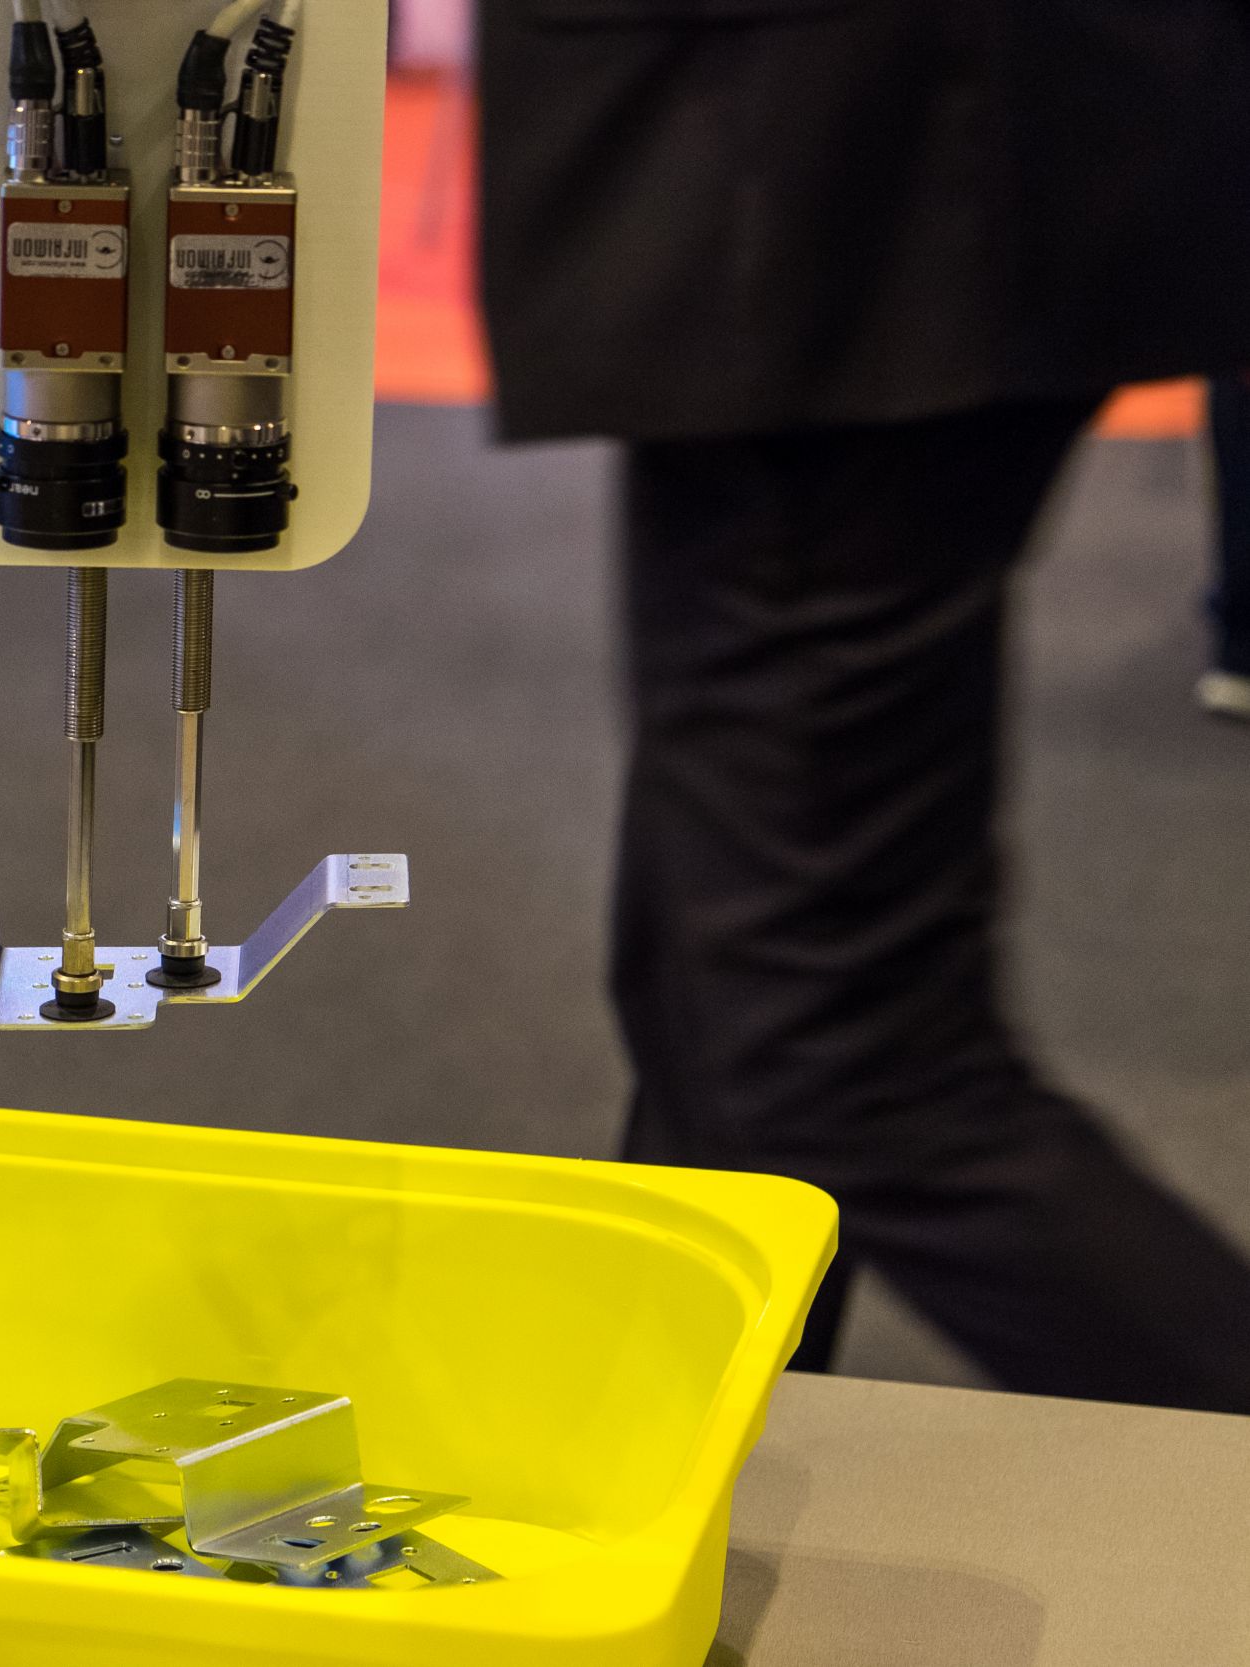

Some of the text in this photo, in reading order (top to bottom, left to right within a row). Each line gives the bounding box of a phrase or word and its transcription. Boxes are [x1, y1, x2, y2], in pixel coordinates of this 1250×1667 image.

[12, 238, 88, 258] INFAIMON
[175, 249, 251, 269] INFAIMON
[9, 483, 39, 496] near
